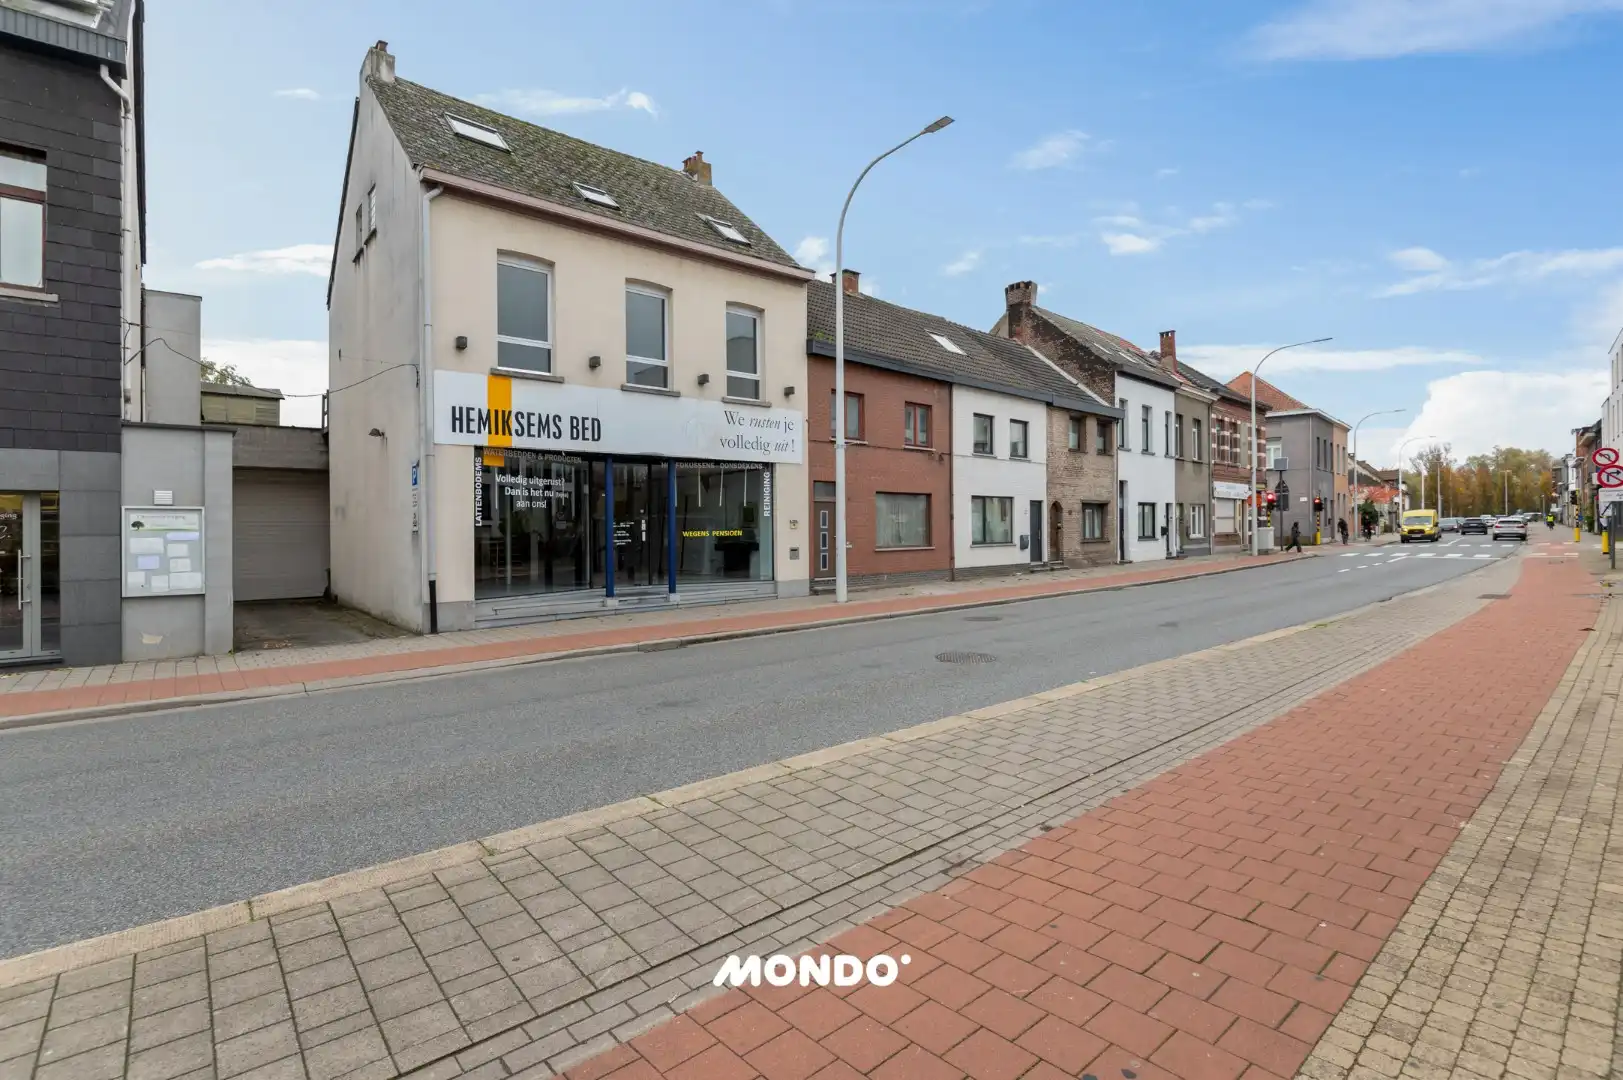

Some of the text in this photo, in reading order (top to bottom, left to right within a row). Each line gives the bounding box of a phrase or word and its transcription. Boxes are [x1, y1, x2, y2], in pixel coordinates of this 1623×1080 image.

[451, 405, 602, 442] HEMIKSEMS BED
[724, 410, 794, 434] We rusten je
[719, 434, 771, 456] volledig
[483, 447, 537, 460] WATERBEDDEN
[544, 453, 582, 464] PRODUCTEN
[719, 462, 763, 471] DONSDEKENS
[495, 473, 565, 487] Volledig uitgerust?
[504, 486, 521, 496] Dan
[522, 487, 529, 497] is
[530, 487, 543, 497] het
[544, 489, 554, 498] nu
[763, 471, 771, 517] REINIGING
[531, 499, 547, 509] ons!
[682, 529, 743, 538] WEGENS PENSIOEN
